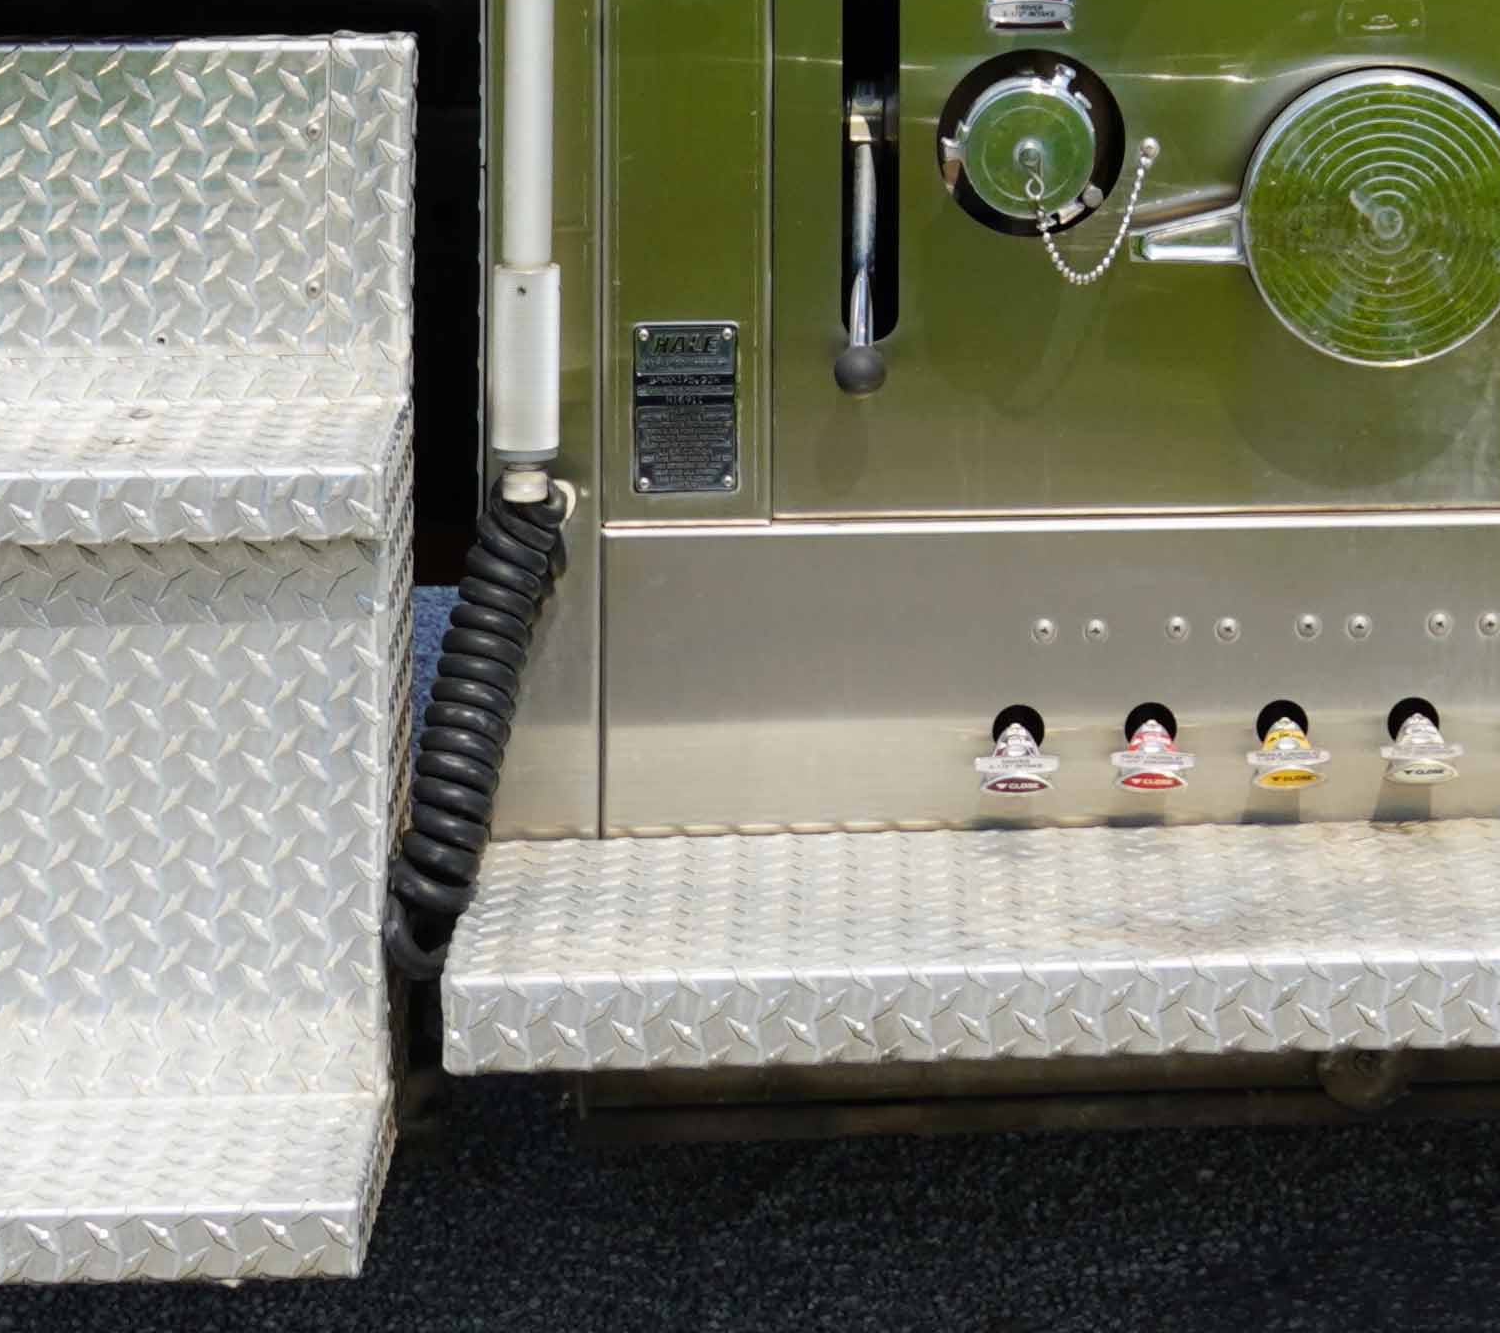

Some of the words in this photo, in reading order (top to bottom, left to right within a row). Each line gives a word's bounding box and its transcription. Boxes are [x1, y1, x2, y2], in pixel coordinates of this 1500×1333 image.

[653, 333, 721, 356] HALE
[1415, 768, 1445, 776] CLOSE
[1140, 778, 1174, 786] CLOSE
